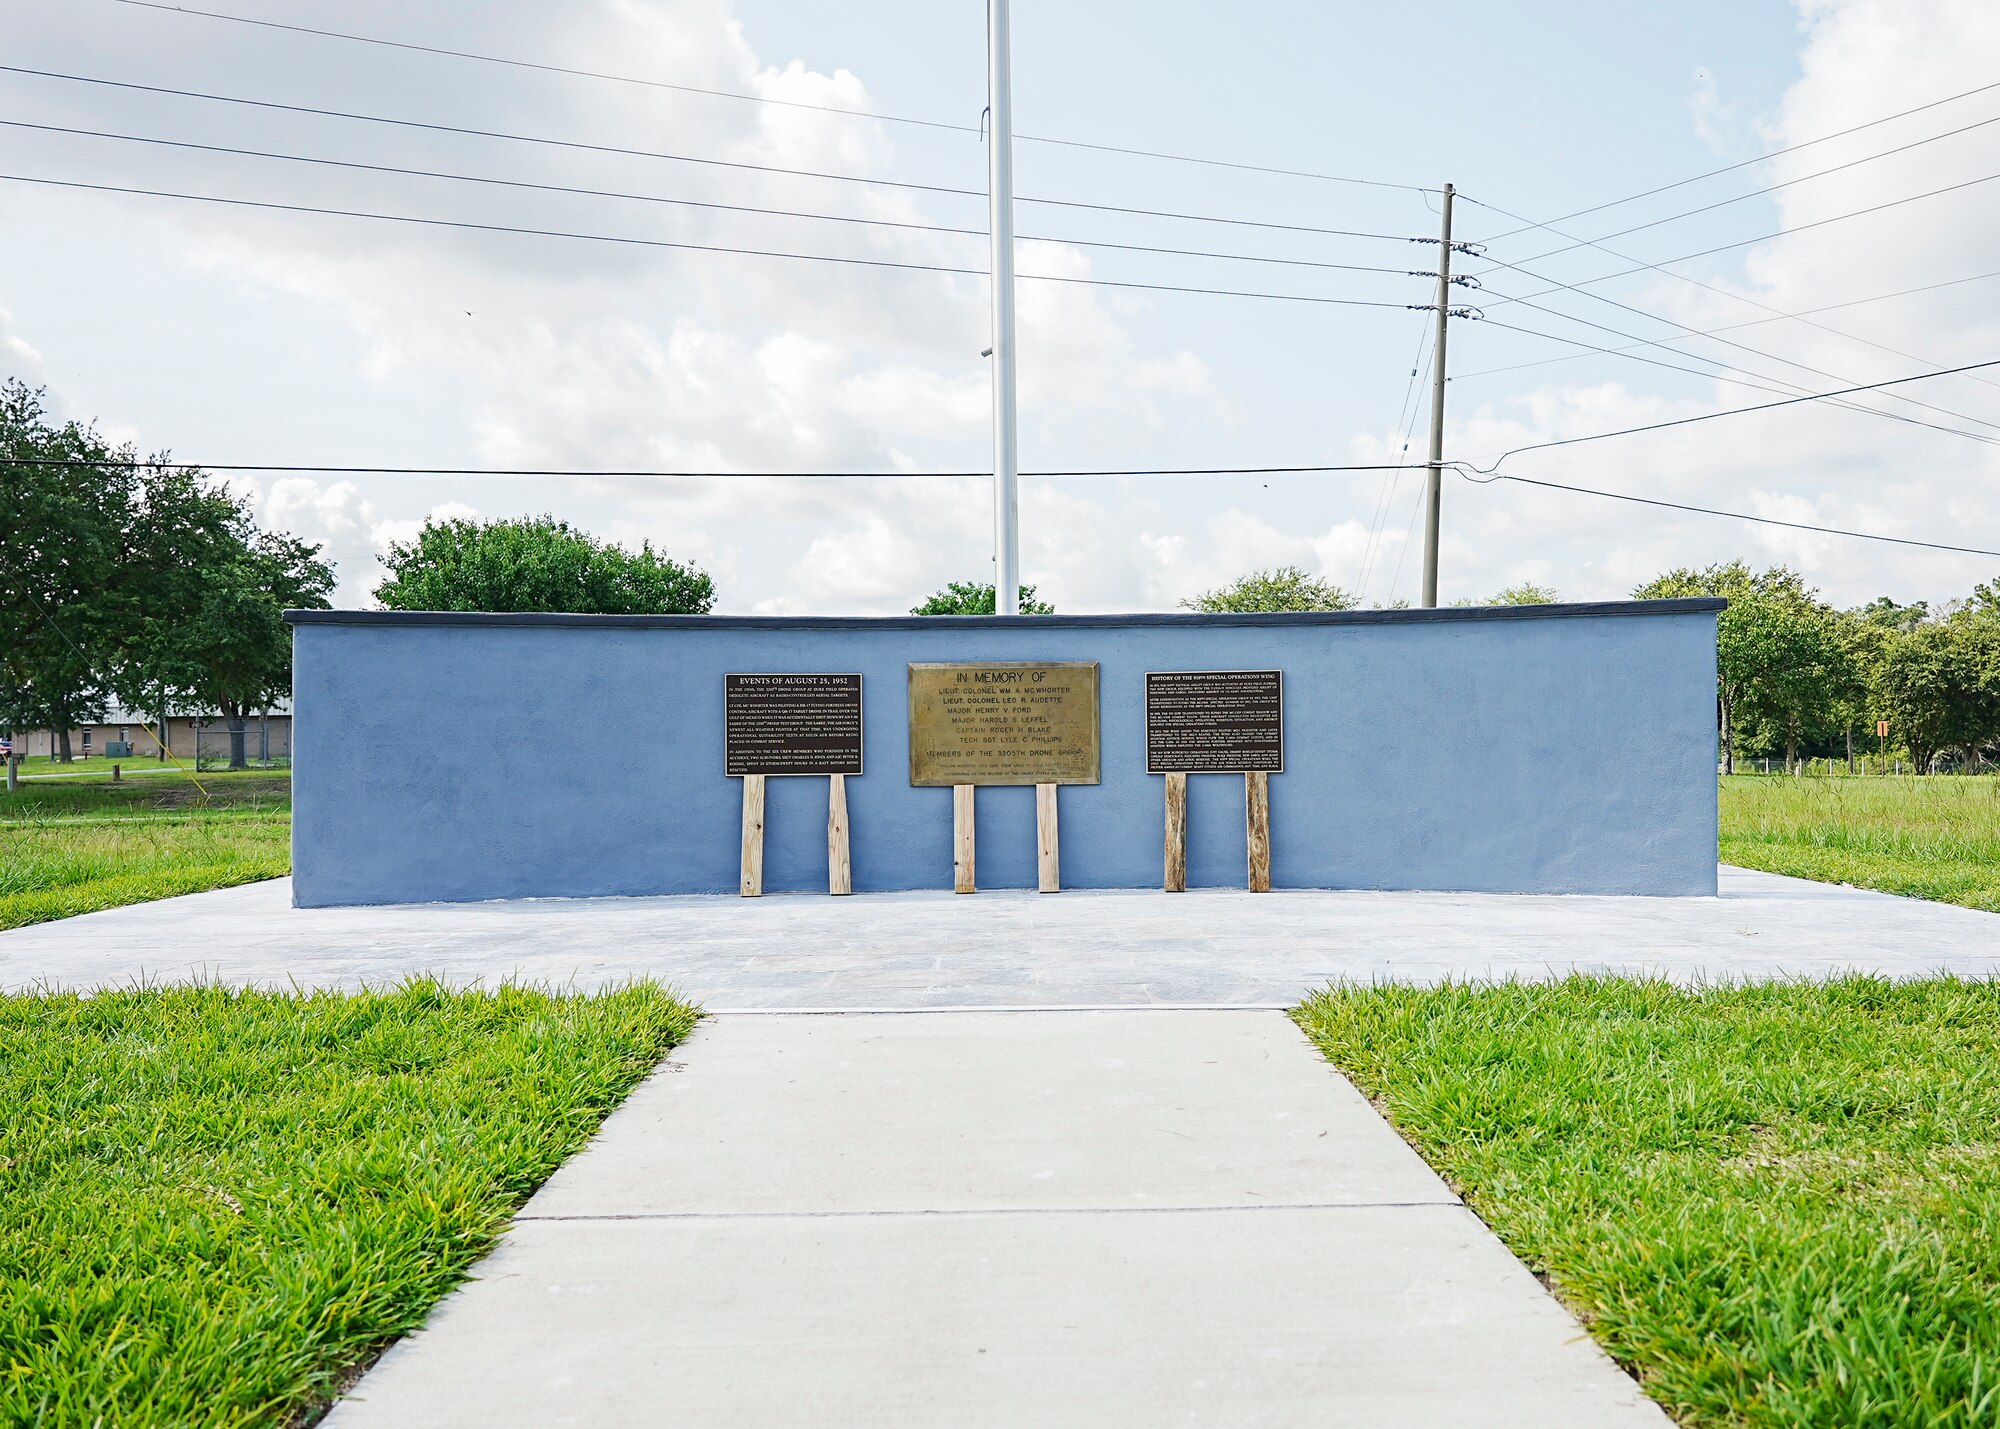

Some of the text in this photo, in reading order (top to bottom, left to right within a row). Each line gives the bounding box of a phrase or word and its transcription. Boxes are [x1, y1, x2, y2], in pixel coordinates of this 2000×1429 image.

[957, 672, 1046, 682] IN MEMORY OF
